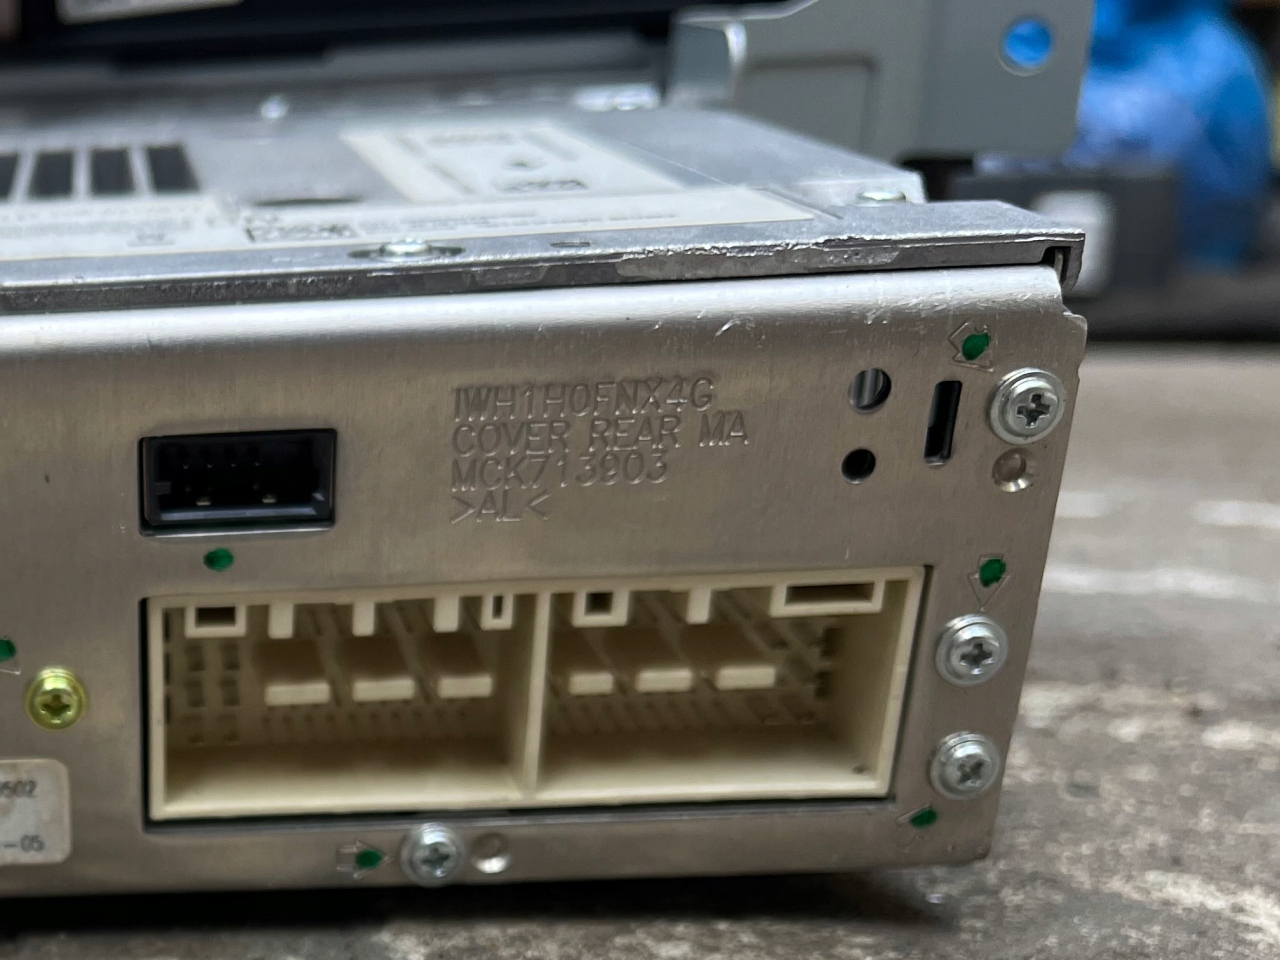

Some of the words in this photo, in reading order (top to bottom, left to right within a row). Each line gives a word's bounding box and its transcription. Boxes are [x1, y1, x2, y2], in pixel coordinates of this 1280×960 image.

[451, 420, 572, 457] COVER
[588, 414, 683, 451] REAR
[697, 409, 751, 447] MA
